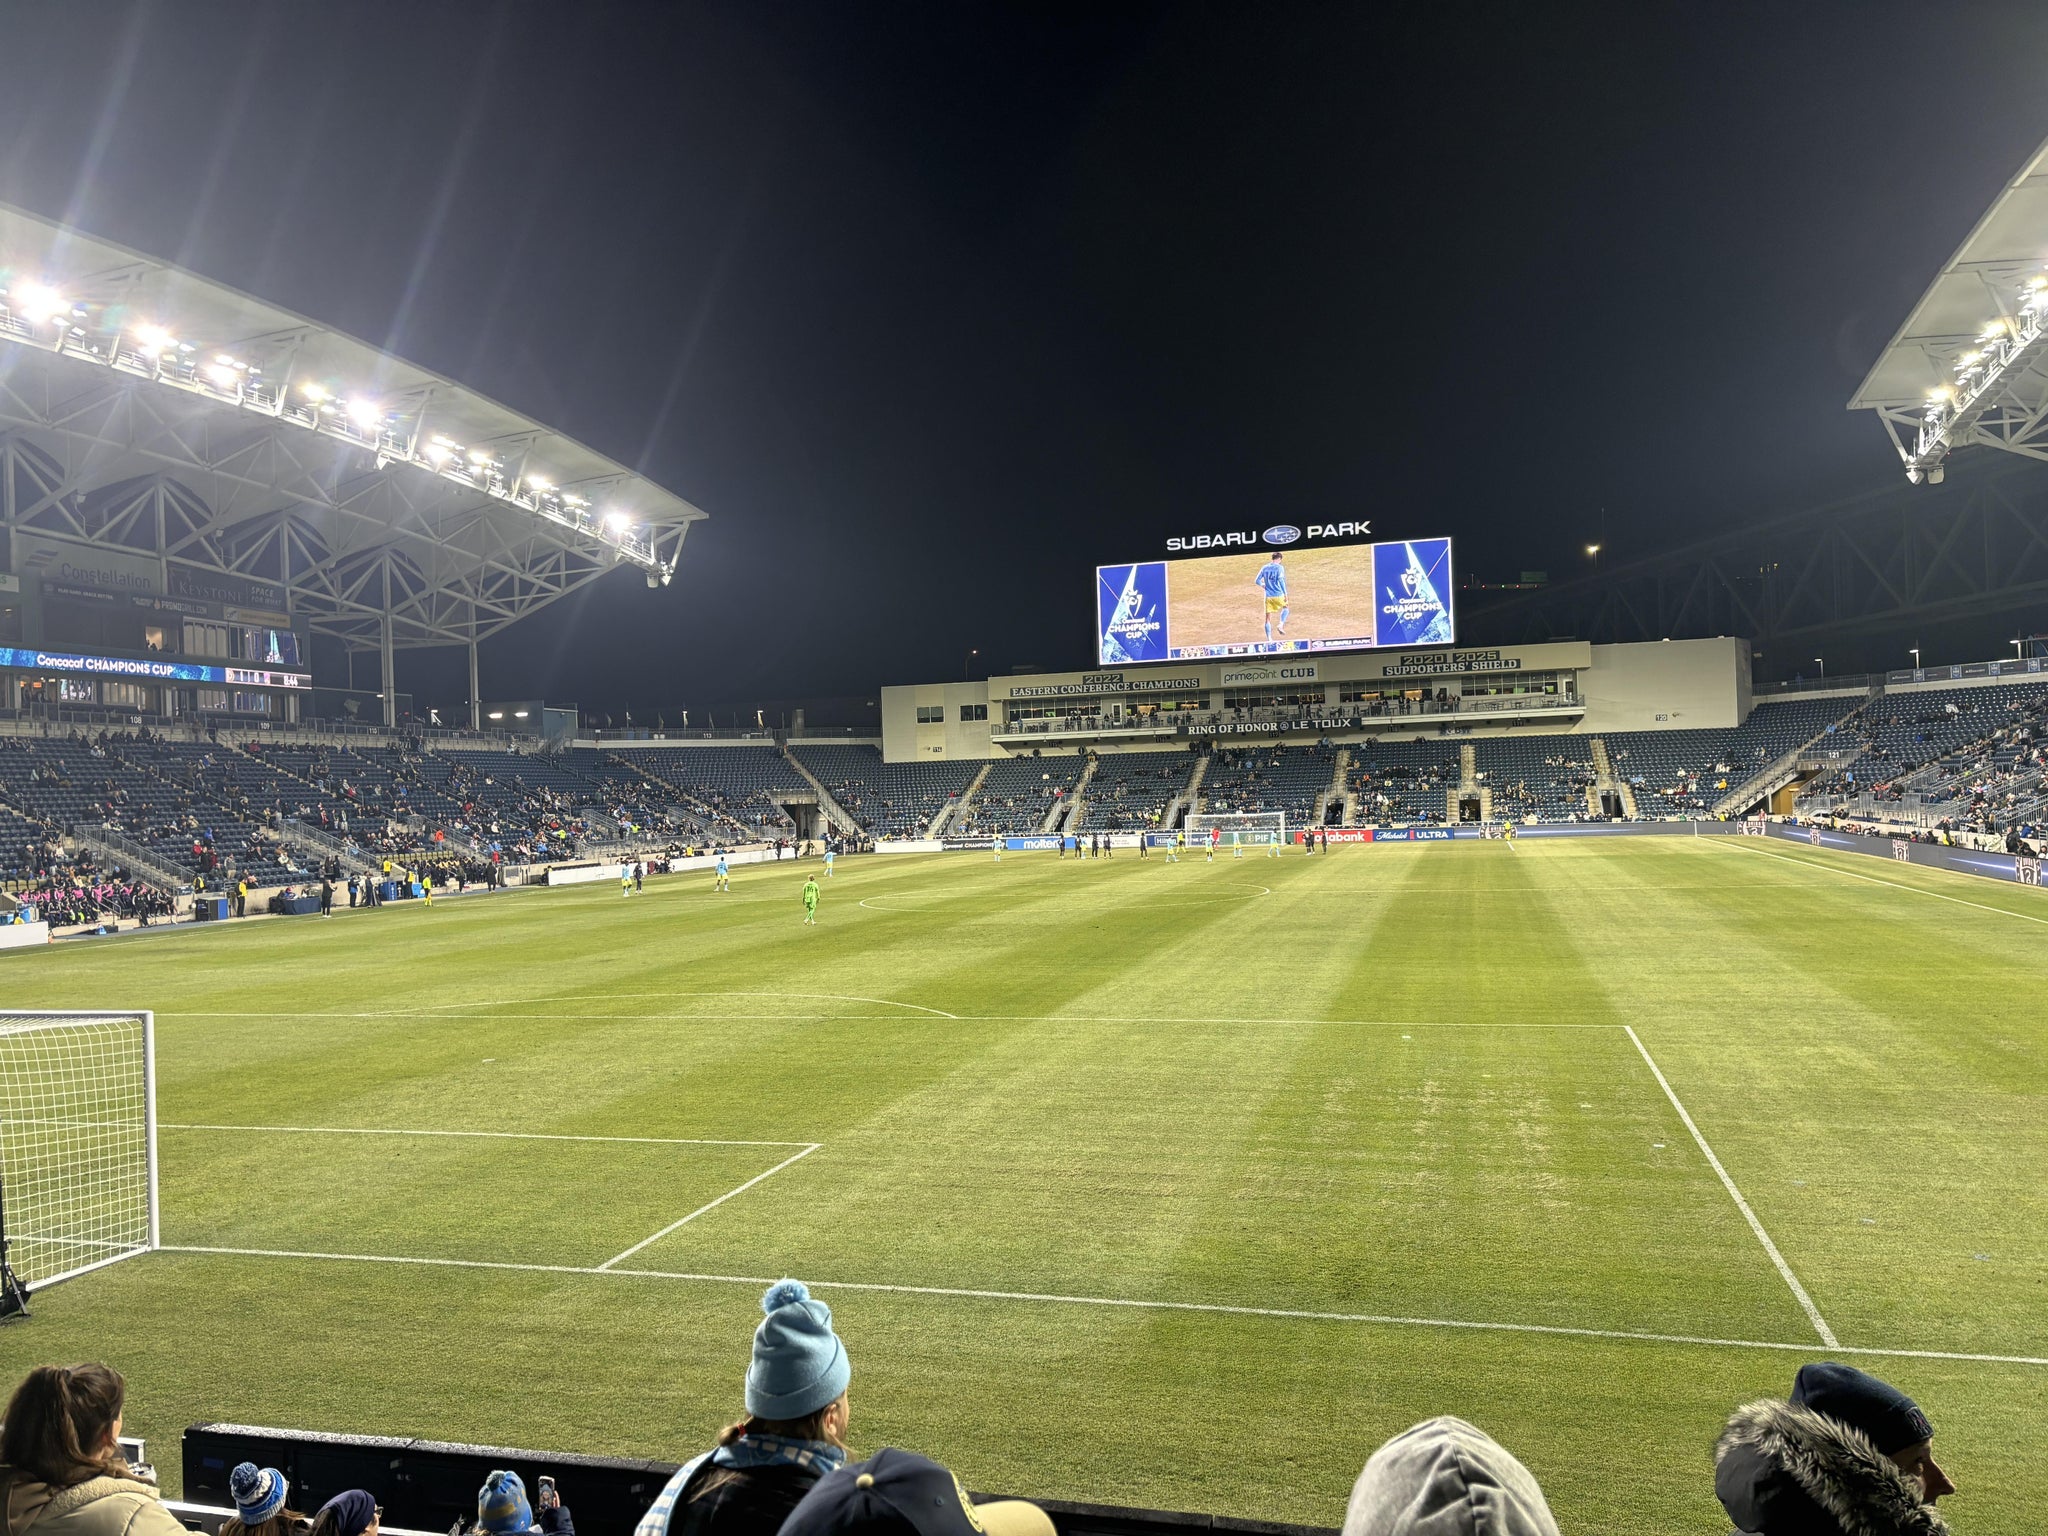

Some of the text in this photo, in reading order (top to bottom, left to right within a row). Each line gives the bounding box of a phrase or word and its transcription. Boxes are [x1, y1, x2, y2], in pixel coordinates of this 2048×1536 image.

[1166, 520, 1371, 551] SUBARU PARK
[62, 562, 150, 588] Constellation
[251, 586, 274, 598] SPACE
[1384, 602, 1441, 613] CHAMPIONS
[1404, 612, 1422, 620] CUP
[1108, 622, 1160, 632] CHAMPIONS
[37, 653, 174, 676] Concacaf CHAMPIONS CUP
[1403, 651, 1497, 665] 2020 2025
[1386, 660, 1517, 676] SUPPORTERS' SHIELD
[254, 672, 259, 683] 0
[1085, 675, 1121, 684] 2022
[1224, 668, 1315, 684] primepoint CLUB
[1012, 679, 1198, 696] EASTERN CONFERENCE CHAMPIONS
[130, 716, 141, 724] 108
[1188, 718, 1351, 735] RING OF HONOR LE TOUX
